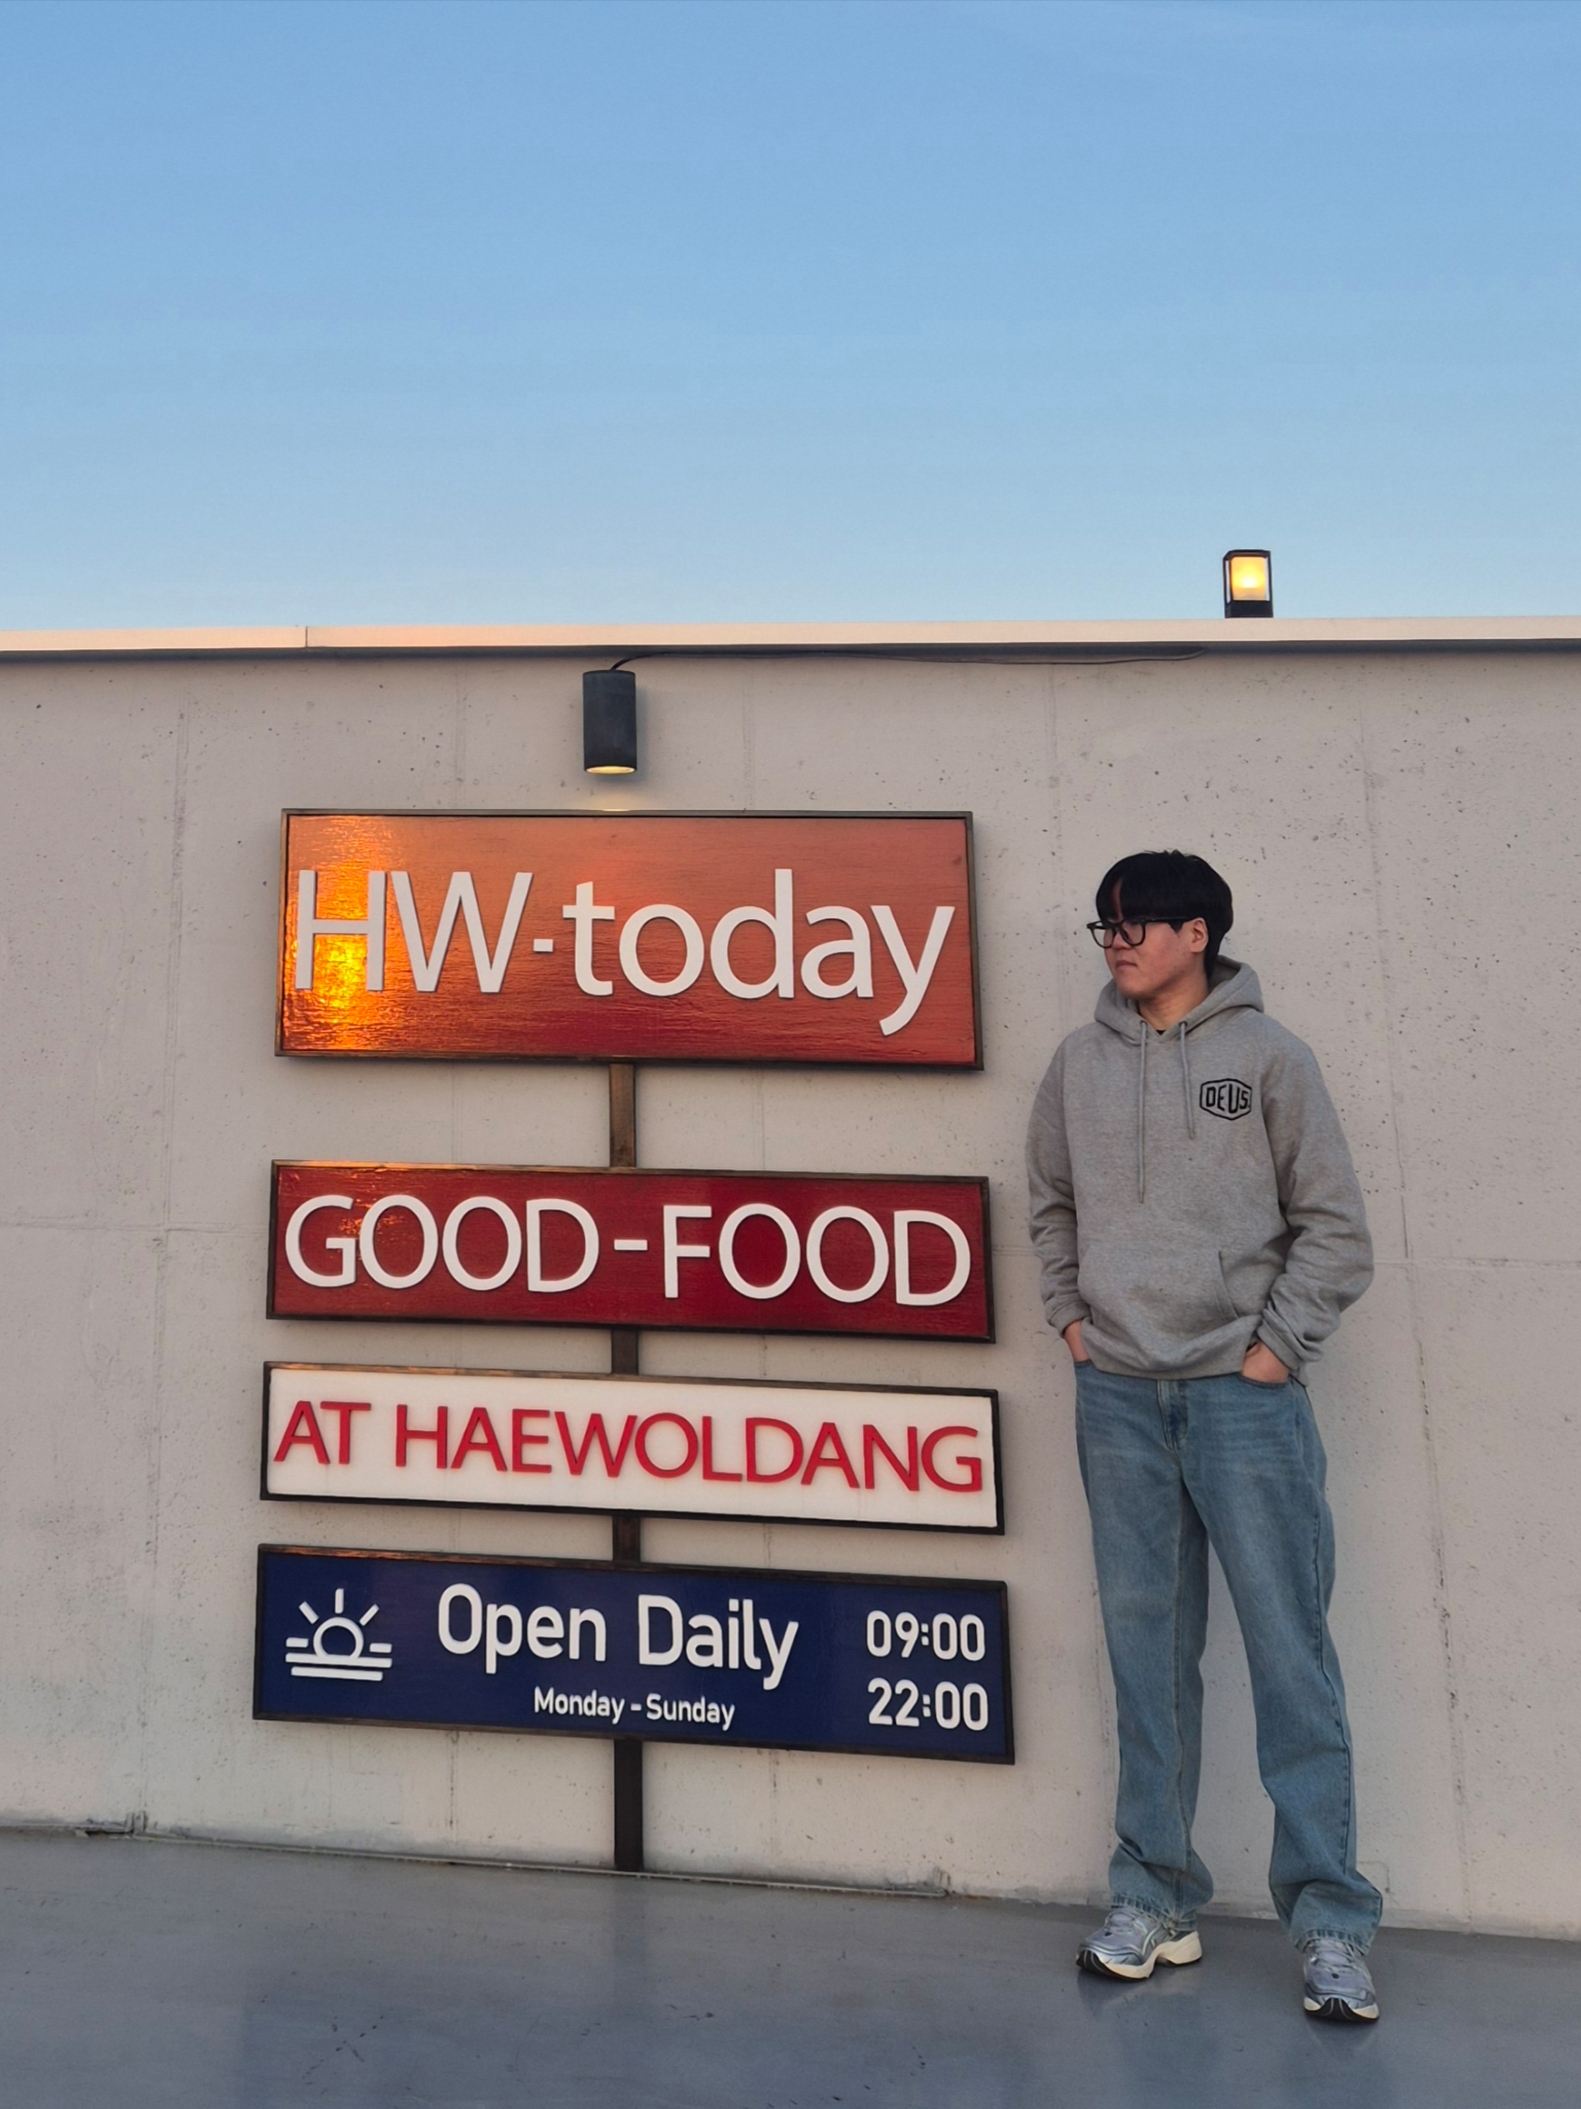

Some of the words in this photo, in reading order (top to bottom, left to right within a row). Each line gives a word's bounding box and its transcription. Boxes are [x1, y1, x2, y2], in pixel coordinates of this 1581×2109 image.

[294, 868, 955, 1036] HW-today
[1206, 1083, 1249, 1114] DEUS
[274, 1400, 371, 1465] AT
[395, 1404, 983, 1492] HAEWOLDANG
[437, 1583, 606, 1675] Open
[638, 1594, 799, 1690] Daily
[866, 1610, 986, 1662] 09:00
[866, 1679, 989, 1731] 22:00
